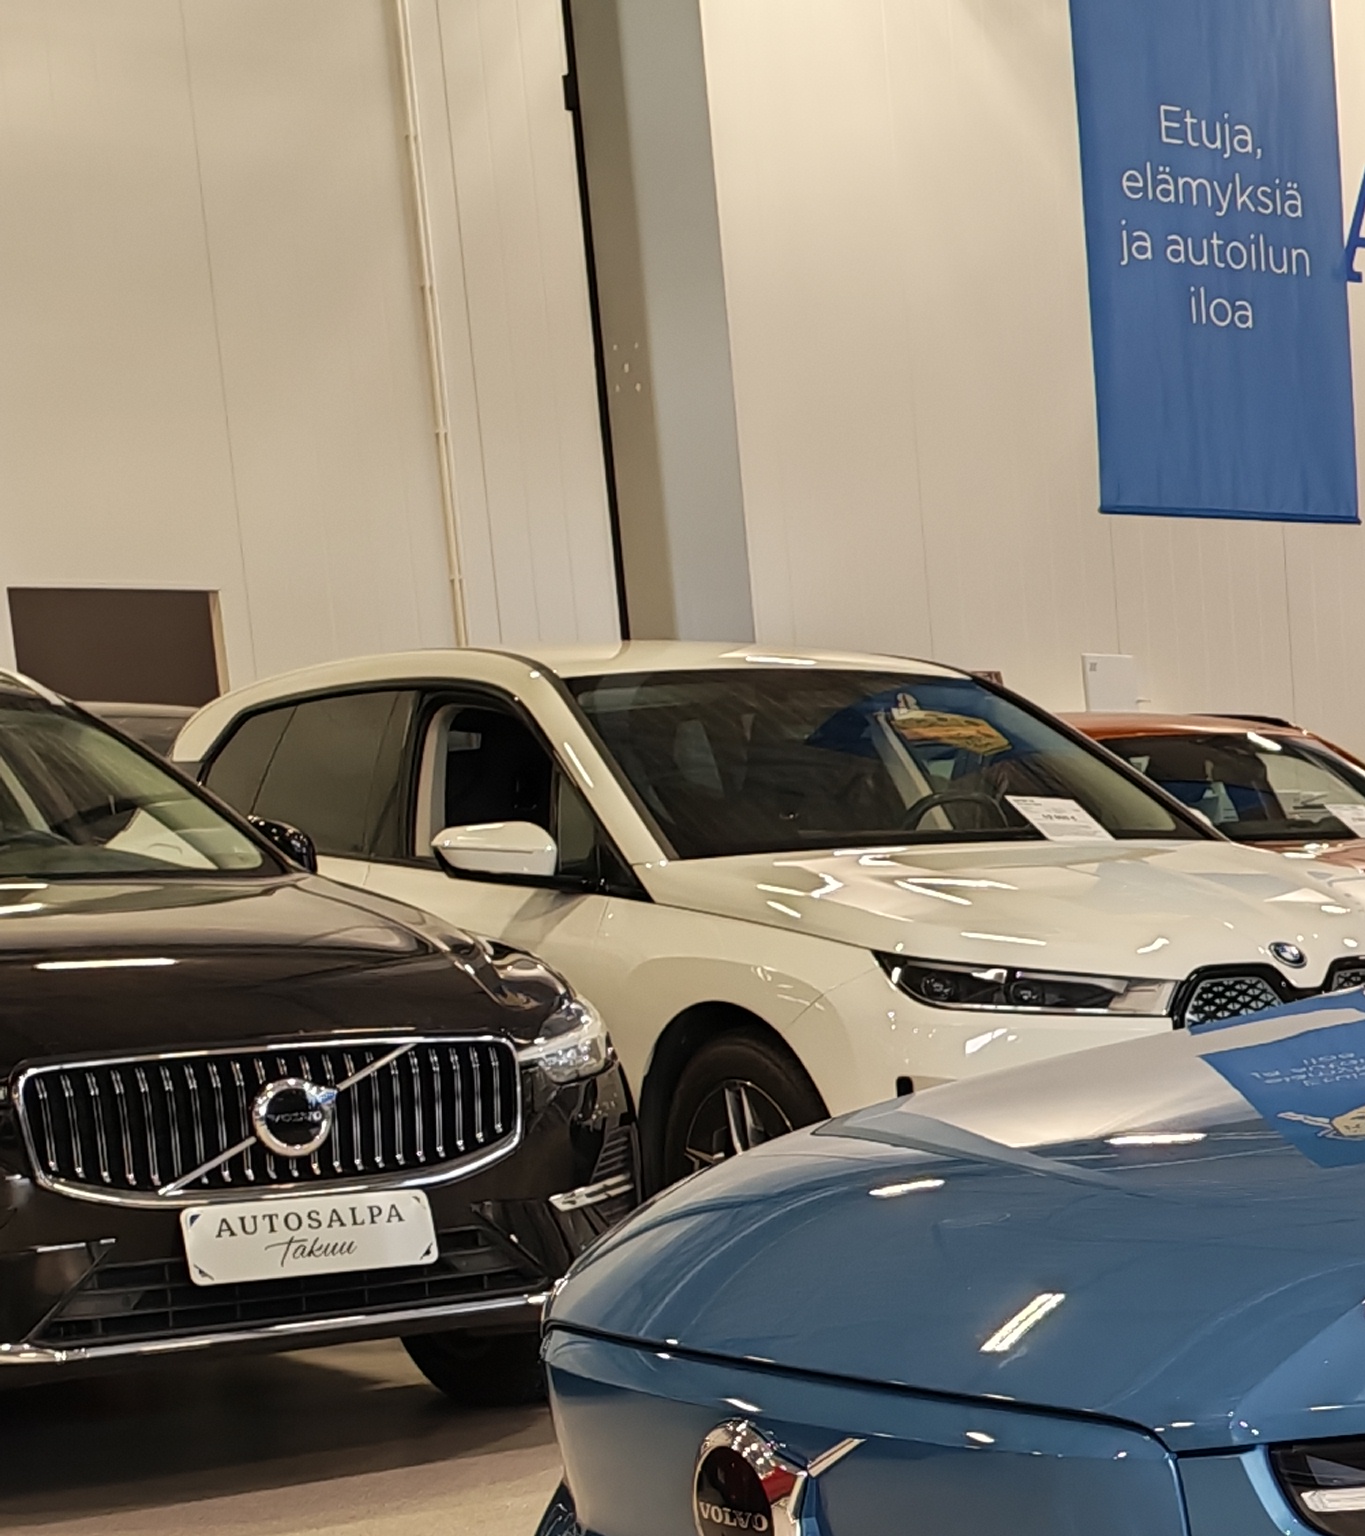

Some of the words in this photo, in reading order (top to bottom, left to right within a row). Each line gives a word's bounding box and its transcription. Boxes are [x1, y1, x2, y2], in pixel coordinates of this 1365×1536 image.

[1159, 104, 1262, 160] Etuja,
[1122, 161, 1303, 218] elämyksiä
[1120, 219, 1152, 266] ja
[1166, 231, 1310, 277] autoilun
[1189, 286, 1253, 329] iloa
[215, 1203, 406, 1239] AUTOSALPA
[264, 1235, 358, 1268] Takuu
[699, 1502, 769, 1532] VOLVO
